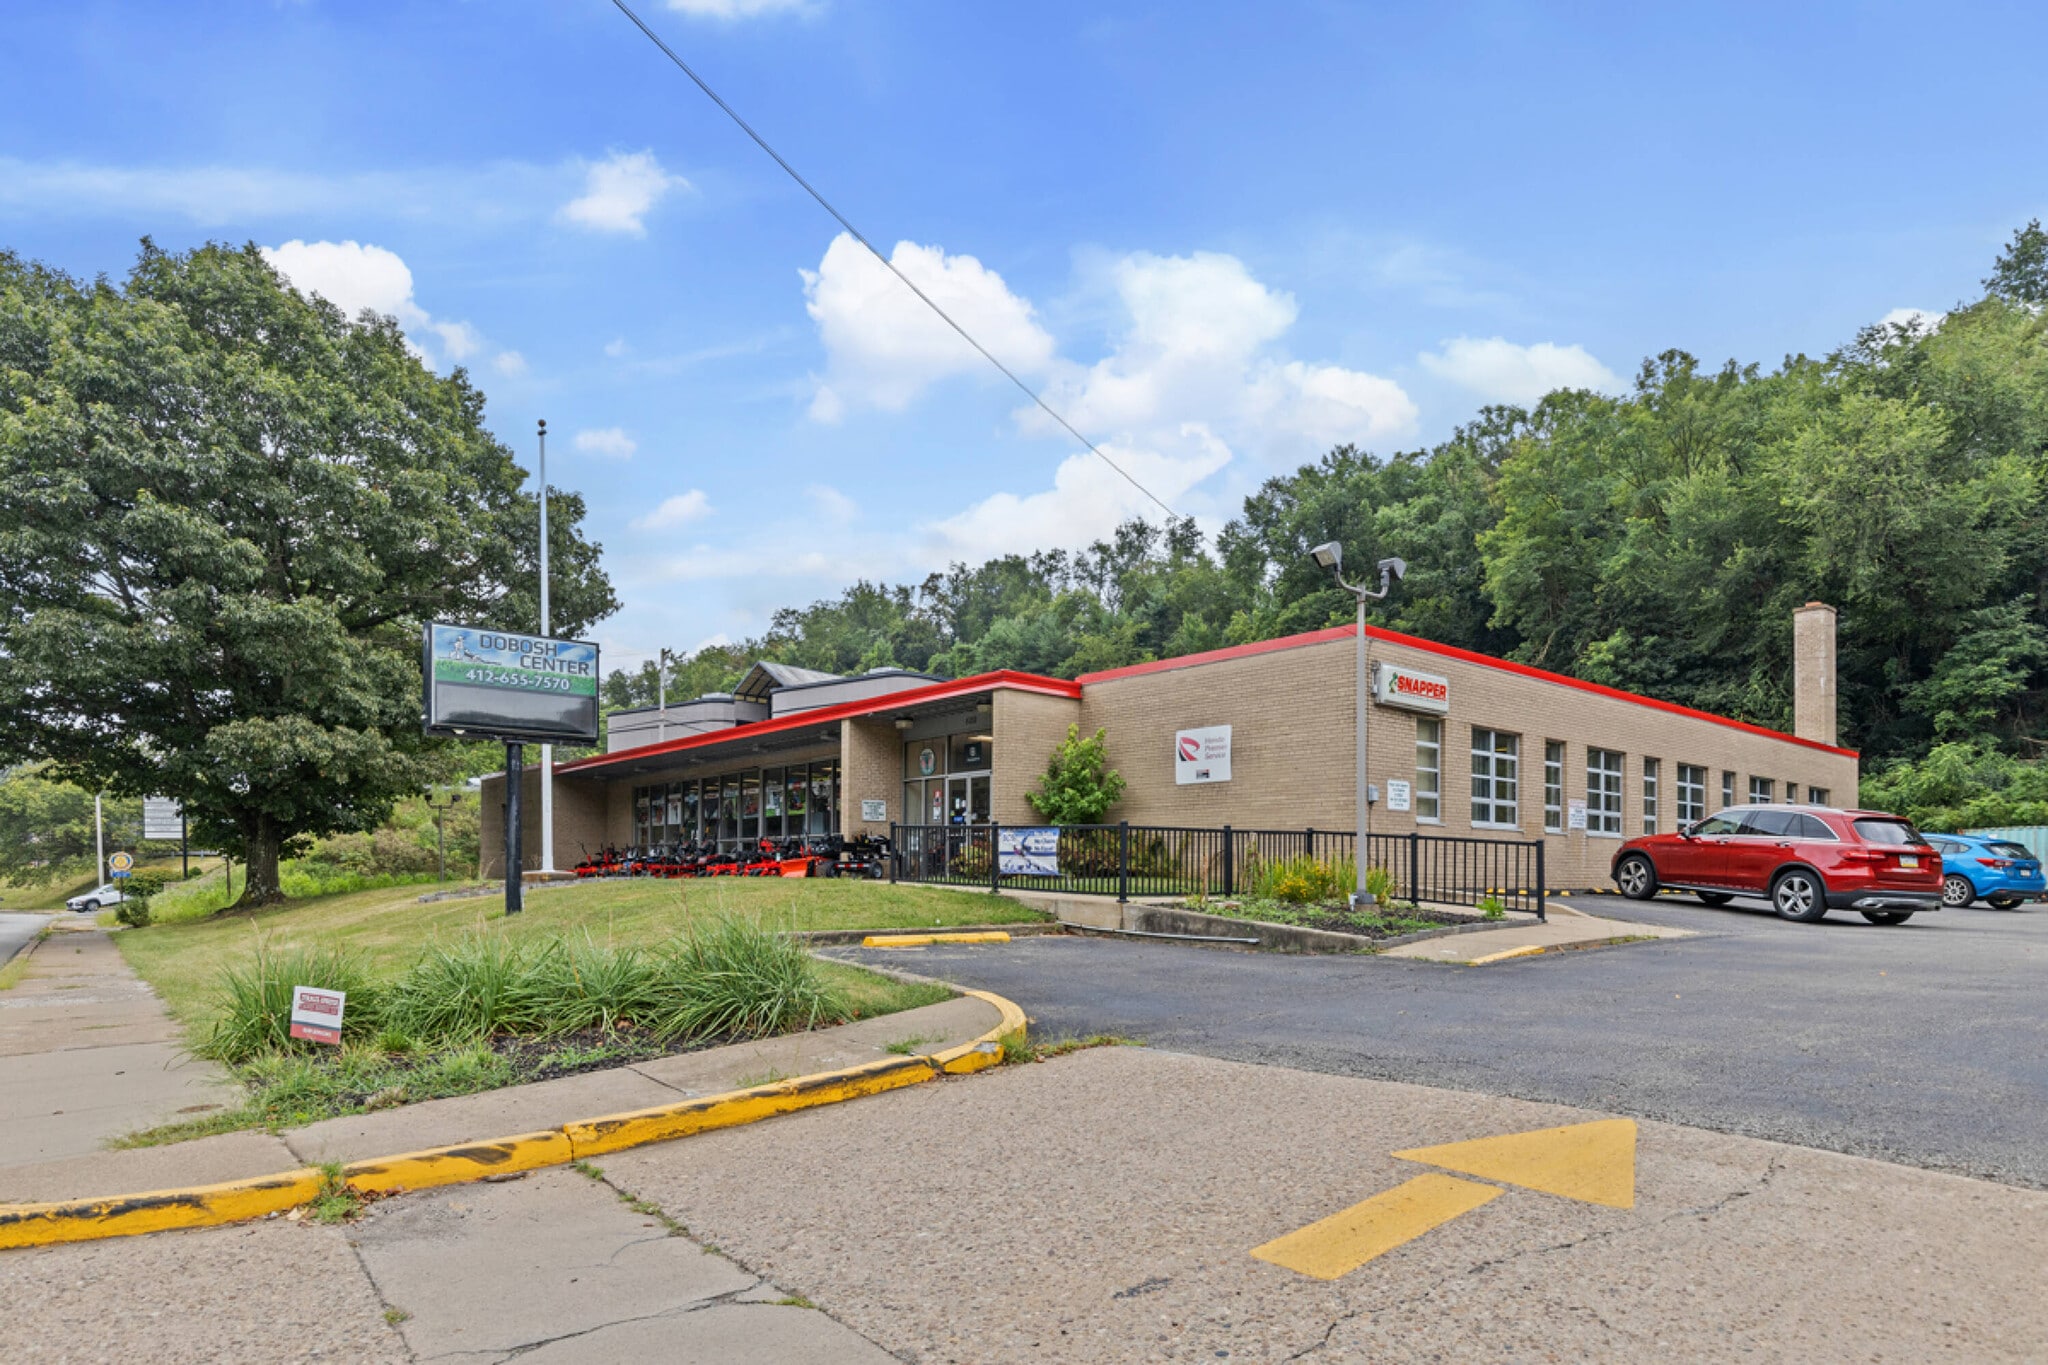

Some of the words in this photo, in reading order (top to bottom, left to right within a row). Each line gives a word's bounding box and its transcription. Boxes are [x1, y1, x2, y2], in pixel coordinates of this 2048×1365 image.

[480, 634, 558, 657] DOBOSH
[520, 655, 590, 676] CENTER
[466, 669, 571, 690] 412-655-7570
[1397, 675, 1447, 699] SNAPPER
